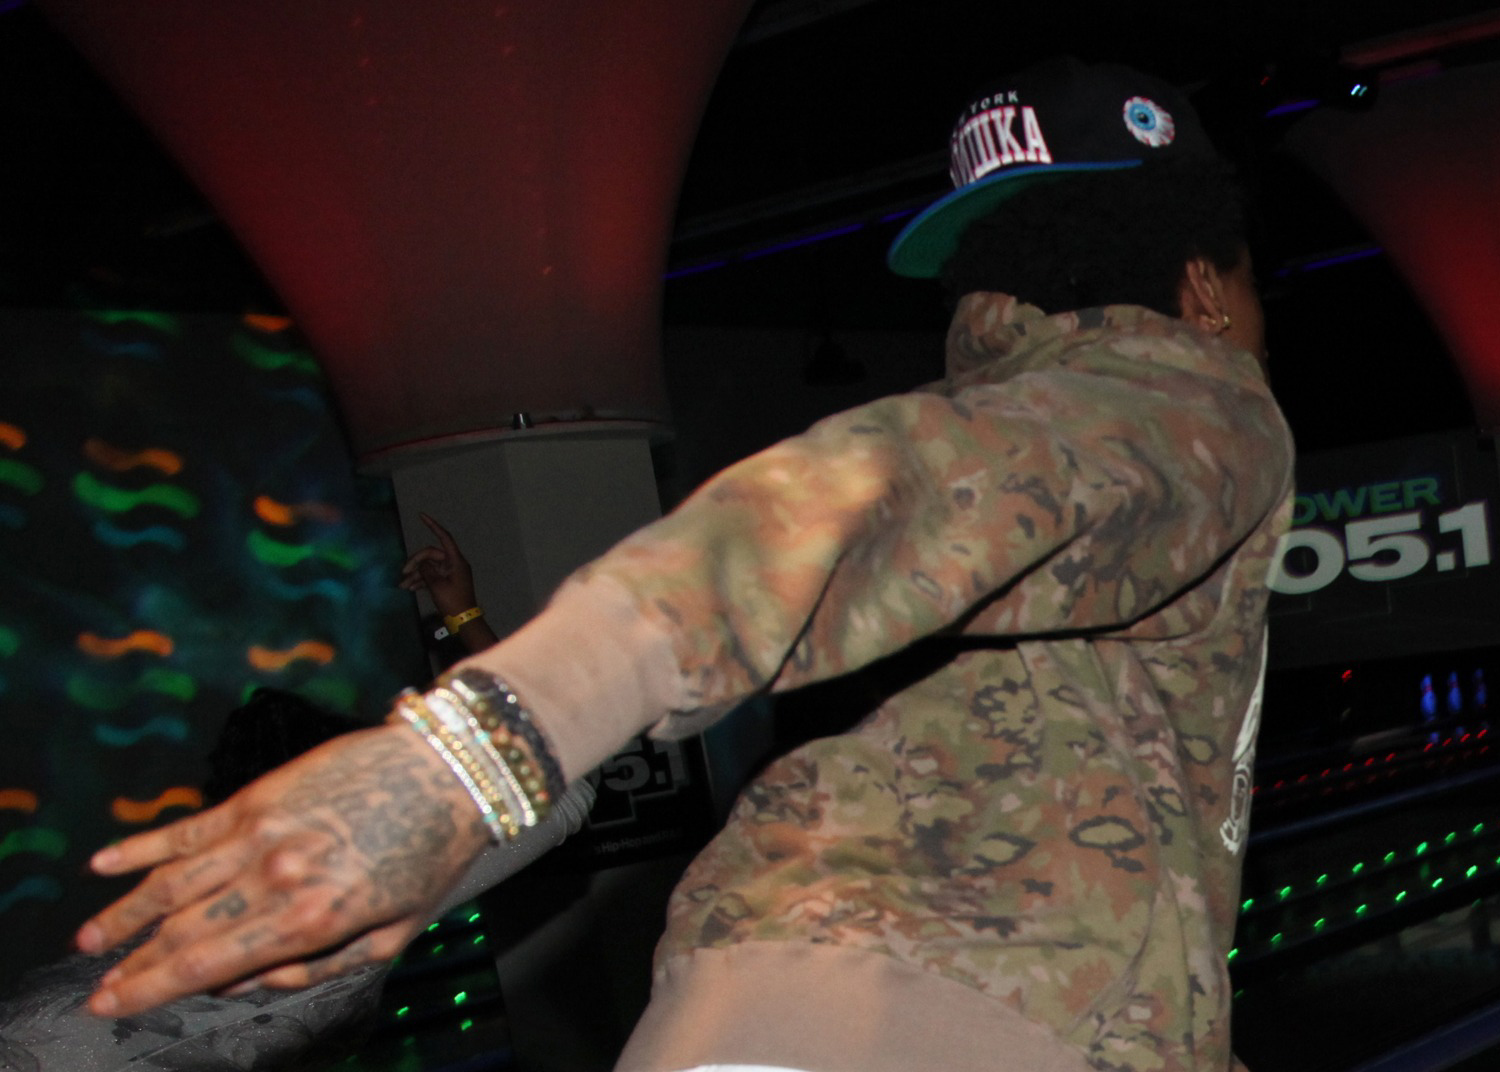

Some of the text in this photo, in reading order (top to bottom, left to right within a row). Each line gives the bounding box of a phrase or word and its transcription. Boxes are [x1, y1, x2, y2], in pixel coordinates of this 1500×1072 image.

[970, 90, 1018, 114] YORK
[1292, 475, 1442, 526] OWER
[1265, 500, 1492, 595] 05.1
